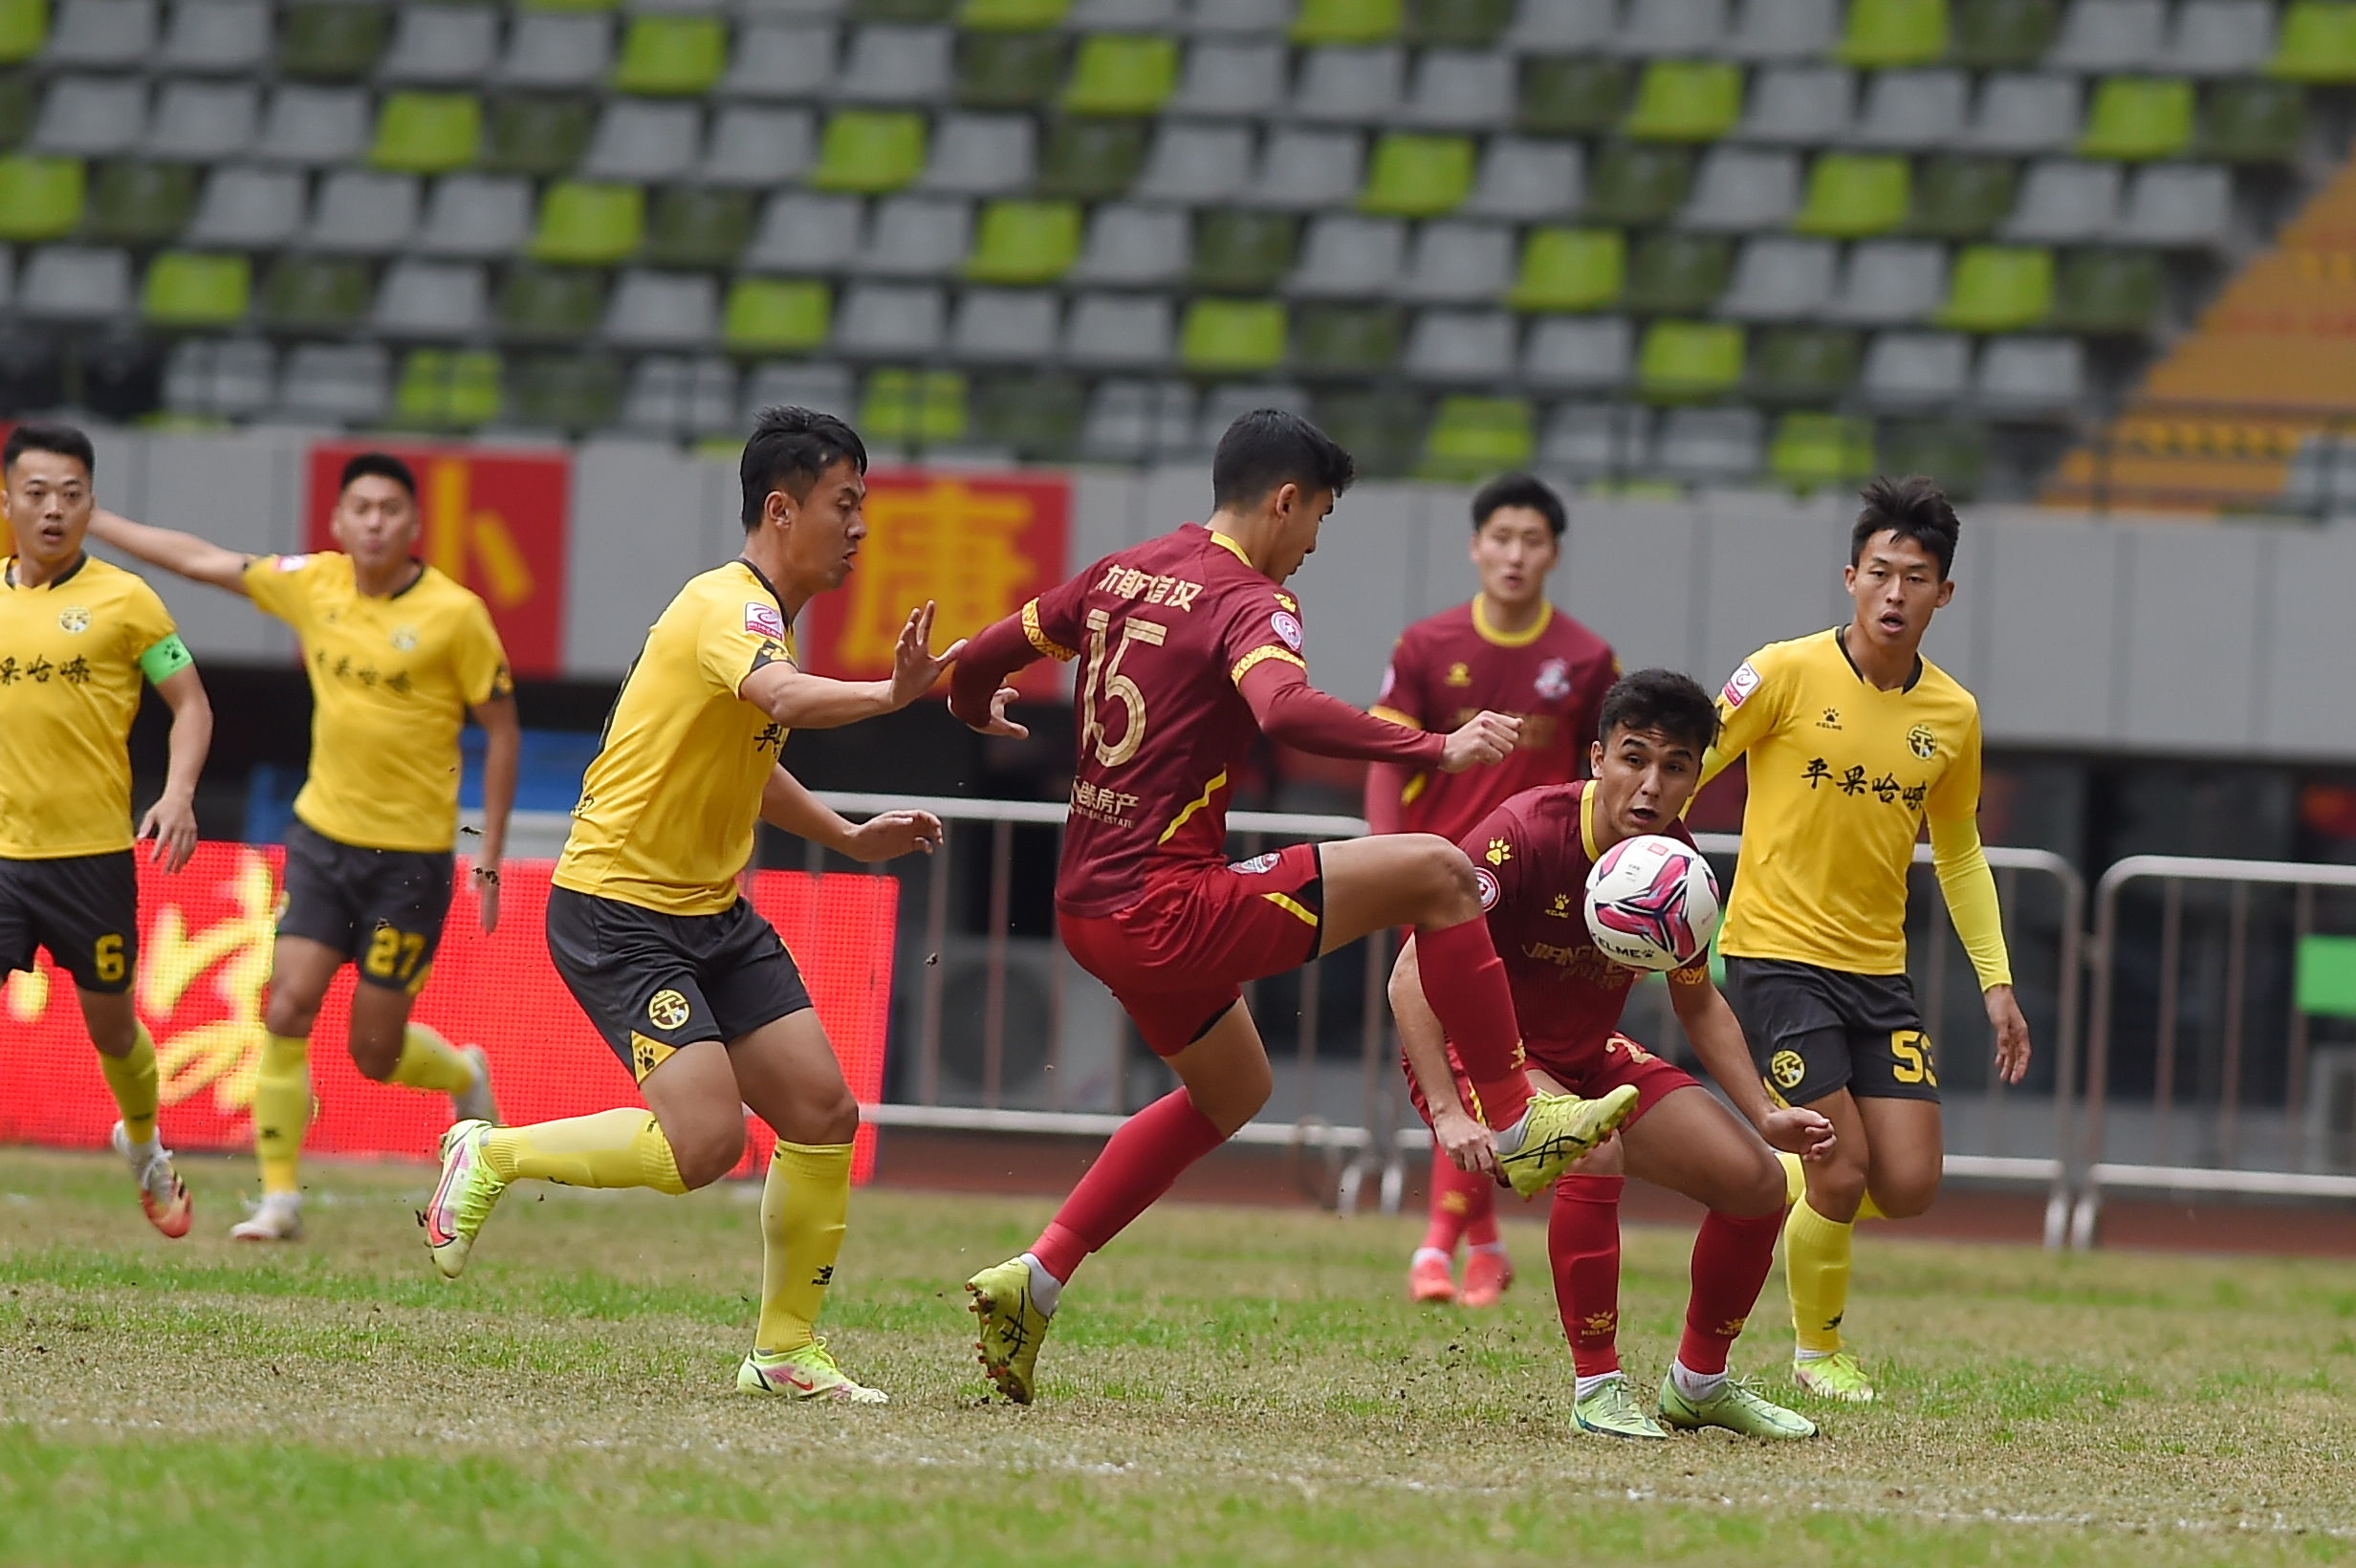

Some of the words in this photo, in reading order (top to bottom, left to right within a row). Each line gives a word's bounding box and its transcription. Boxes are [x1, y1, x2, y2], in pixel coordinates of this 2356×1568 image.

[1081, 608, 1167, 768] 15
[96, 933, 125, 984] 6
[363, 927, 426, 977] 27
